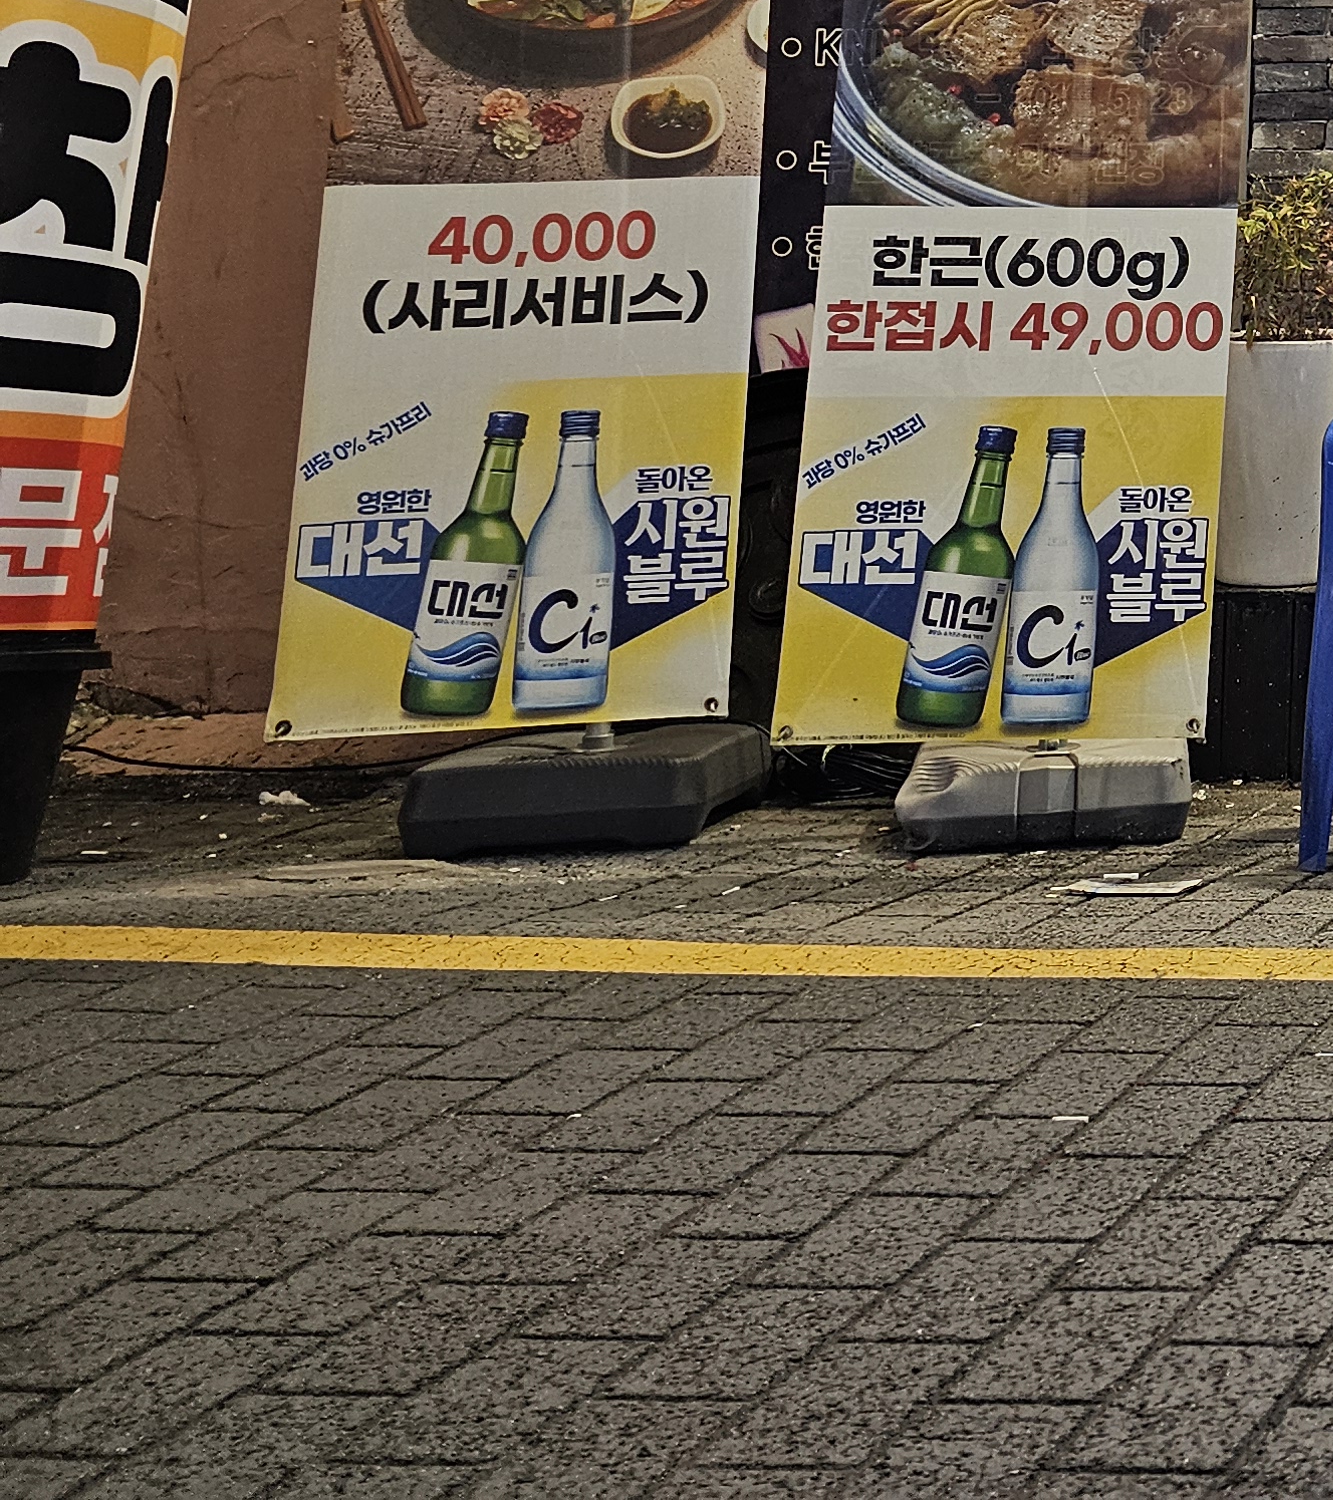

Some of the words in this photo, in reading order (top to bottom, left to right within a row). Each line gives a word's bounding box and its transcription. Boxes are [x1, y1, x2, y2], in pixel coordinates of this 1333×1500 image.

[428, 210, 657, 268] 40,000
[872, 234, 1190, 301] 한근(600g)
[362, 269, 710, 334] (사리서비스)
[826, 301, 993, 353] 한접시
[1009, 300, 1224, 356] 49,000
[300, 450, 335, 483] 과당
[331, 437, 367, 464] 0%
[365, 401, 433, 447] 슈가프리
[801, 462, 835, 490] 과당
[832, 446, 866, 472] 0%
[864, 413, 928, 457] 슈가프리
[356, 489, 432, 516] 영원한
[635, 466, 715, 495] 돌아온
[1118, 487, 1193, 515] 돌아온
[623, 496, 731, 550] 시원
[855, 500, 927, 526] 영원한
[299, 518, 423, 579] 대선
[800, 530, 919, 586] 대선
[1107, 518, 1208, 570] 시원
[427, 579, 509, 620] 대선
[623, 552, 729, 606] 블루
[1106, 572, 1208, 625] 블루
[921, 590, 998, 632] 대선
